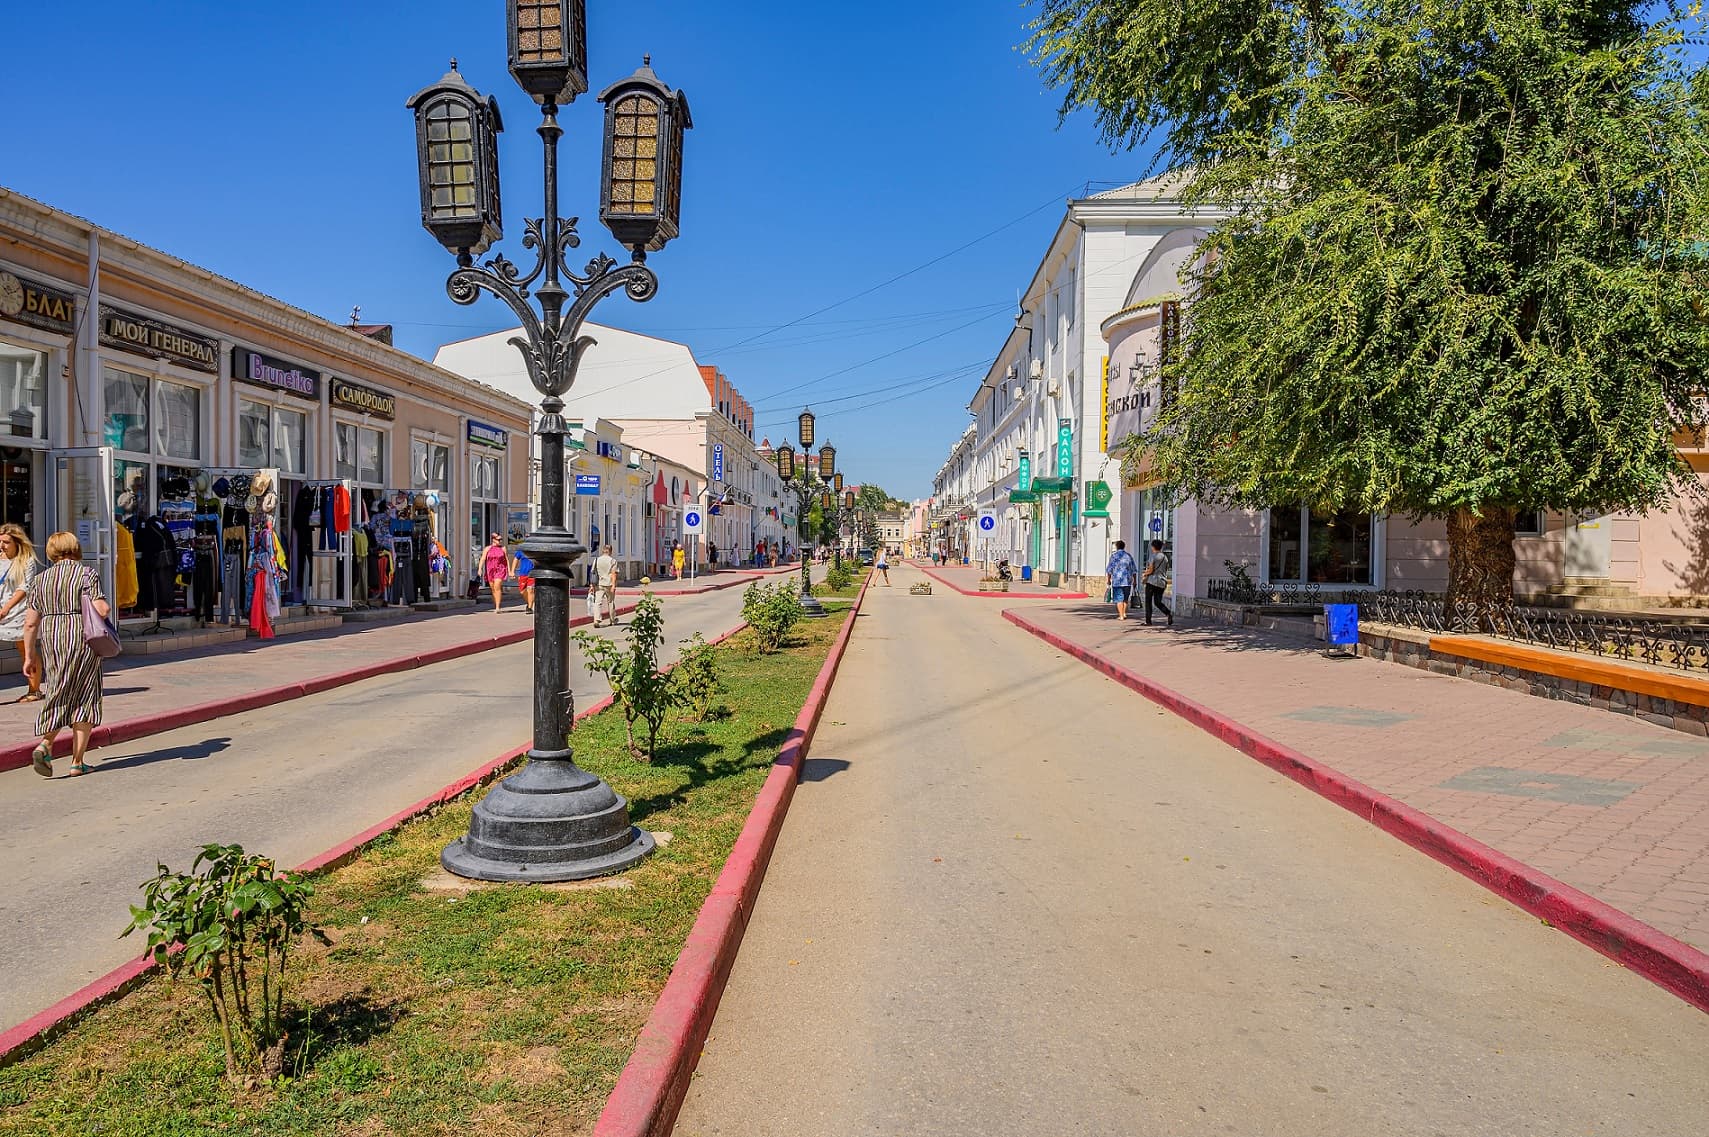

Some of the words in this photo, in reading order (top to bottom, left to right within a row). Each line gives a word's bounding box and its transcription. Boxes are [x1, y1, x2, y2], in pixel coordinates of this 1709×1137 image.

[113, 318, 149, 345] МОЙ
[153, 329, 214, 363] ГЕНЕРАЛ
[250, 353, 313, 395] Brunetka
[340, 386, 394, 413] САМОРОДОК
[714, 445, 722, 481] ОТЕЛЬ
[1061, 428, 1070, 475] САЛОН
